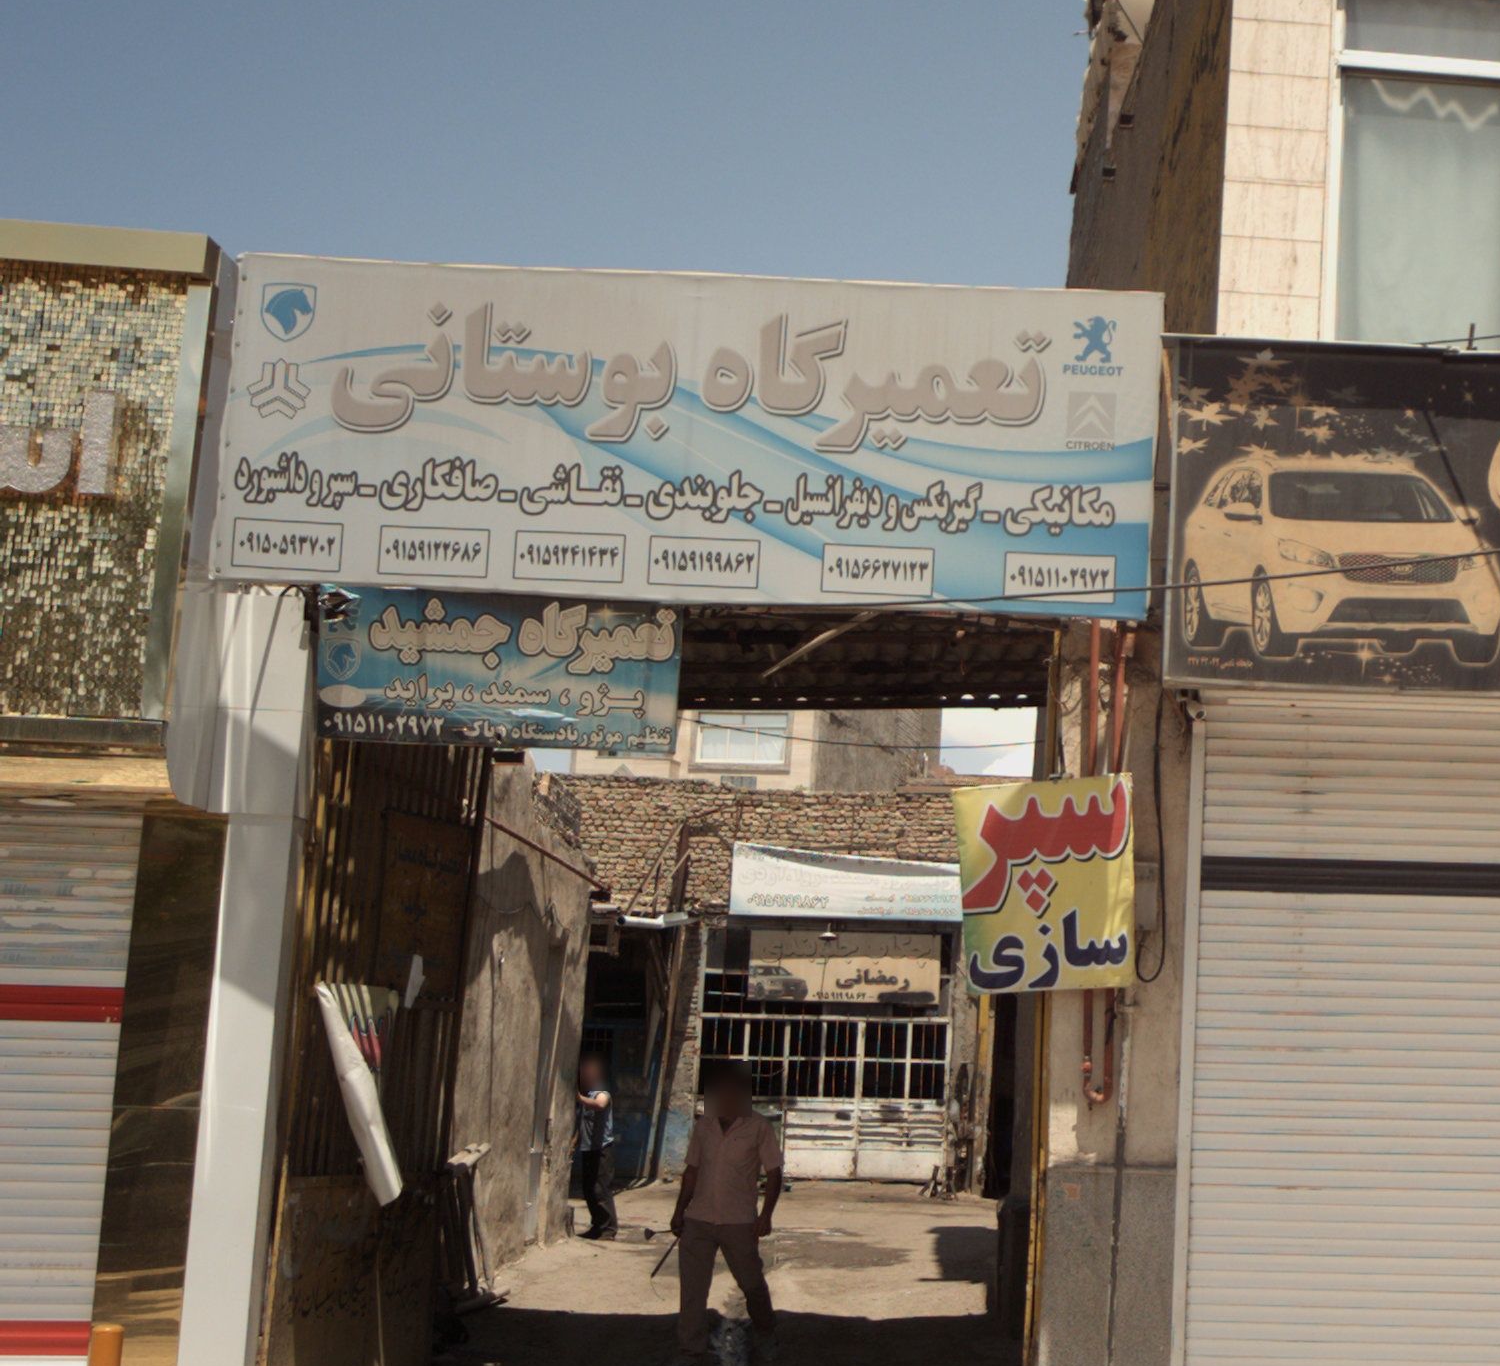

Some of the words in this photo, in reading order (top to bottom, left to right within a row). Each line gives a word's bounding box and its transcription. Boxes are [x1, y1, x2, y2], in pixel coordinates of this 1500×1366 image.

[330, 301, 678, 443] بوستانی
[700, 313, 1051, 453] تعمیرگاه
[1062, 363, 1123, 377] PEUGEOT
[235, 451, 308, 504] داشبورد
[321, 471, 358, 510] سپر
[379, 456, 499, 511] صافکاری
[519, 463, 624, 516] نقاشی
[646, 469, 764, 523] جلوبندی
[784, 472, 883, 529] دیفرانسیل
[900, 479, 983, 533] گیربکس
[1003, 484, 1116, 536] مکانیکی
[654, 549, 755, 573] ۰۹۱۵۹۱۹۹۸۶۲
[828, 557, 929, 582] ۰۹۱۵۶۶۲۷۱۲۳
[368, 597, 512, 670] جمشید
[517, 601, 677, 675] تعمیرگاه
[384, 672, 457, 711] پراید
[480, 680, 551, 706] سمند
[575, 683, 646, 719] پژو
[324, 711, 445, 736] ۰۹۱۵۱۱۰۲۹۷۲
[579, 724, 623, 749] موتور
[627, 725, 673, 750] تنظیم
[962, 779, 1131, 920] سپر
[969, 909, 1129, 990] سازی
[836, 968, 911, 991] رمضانی
